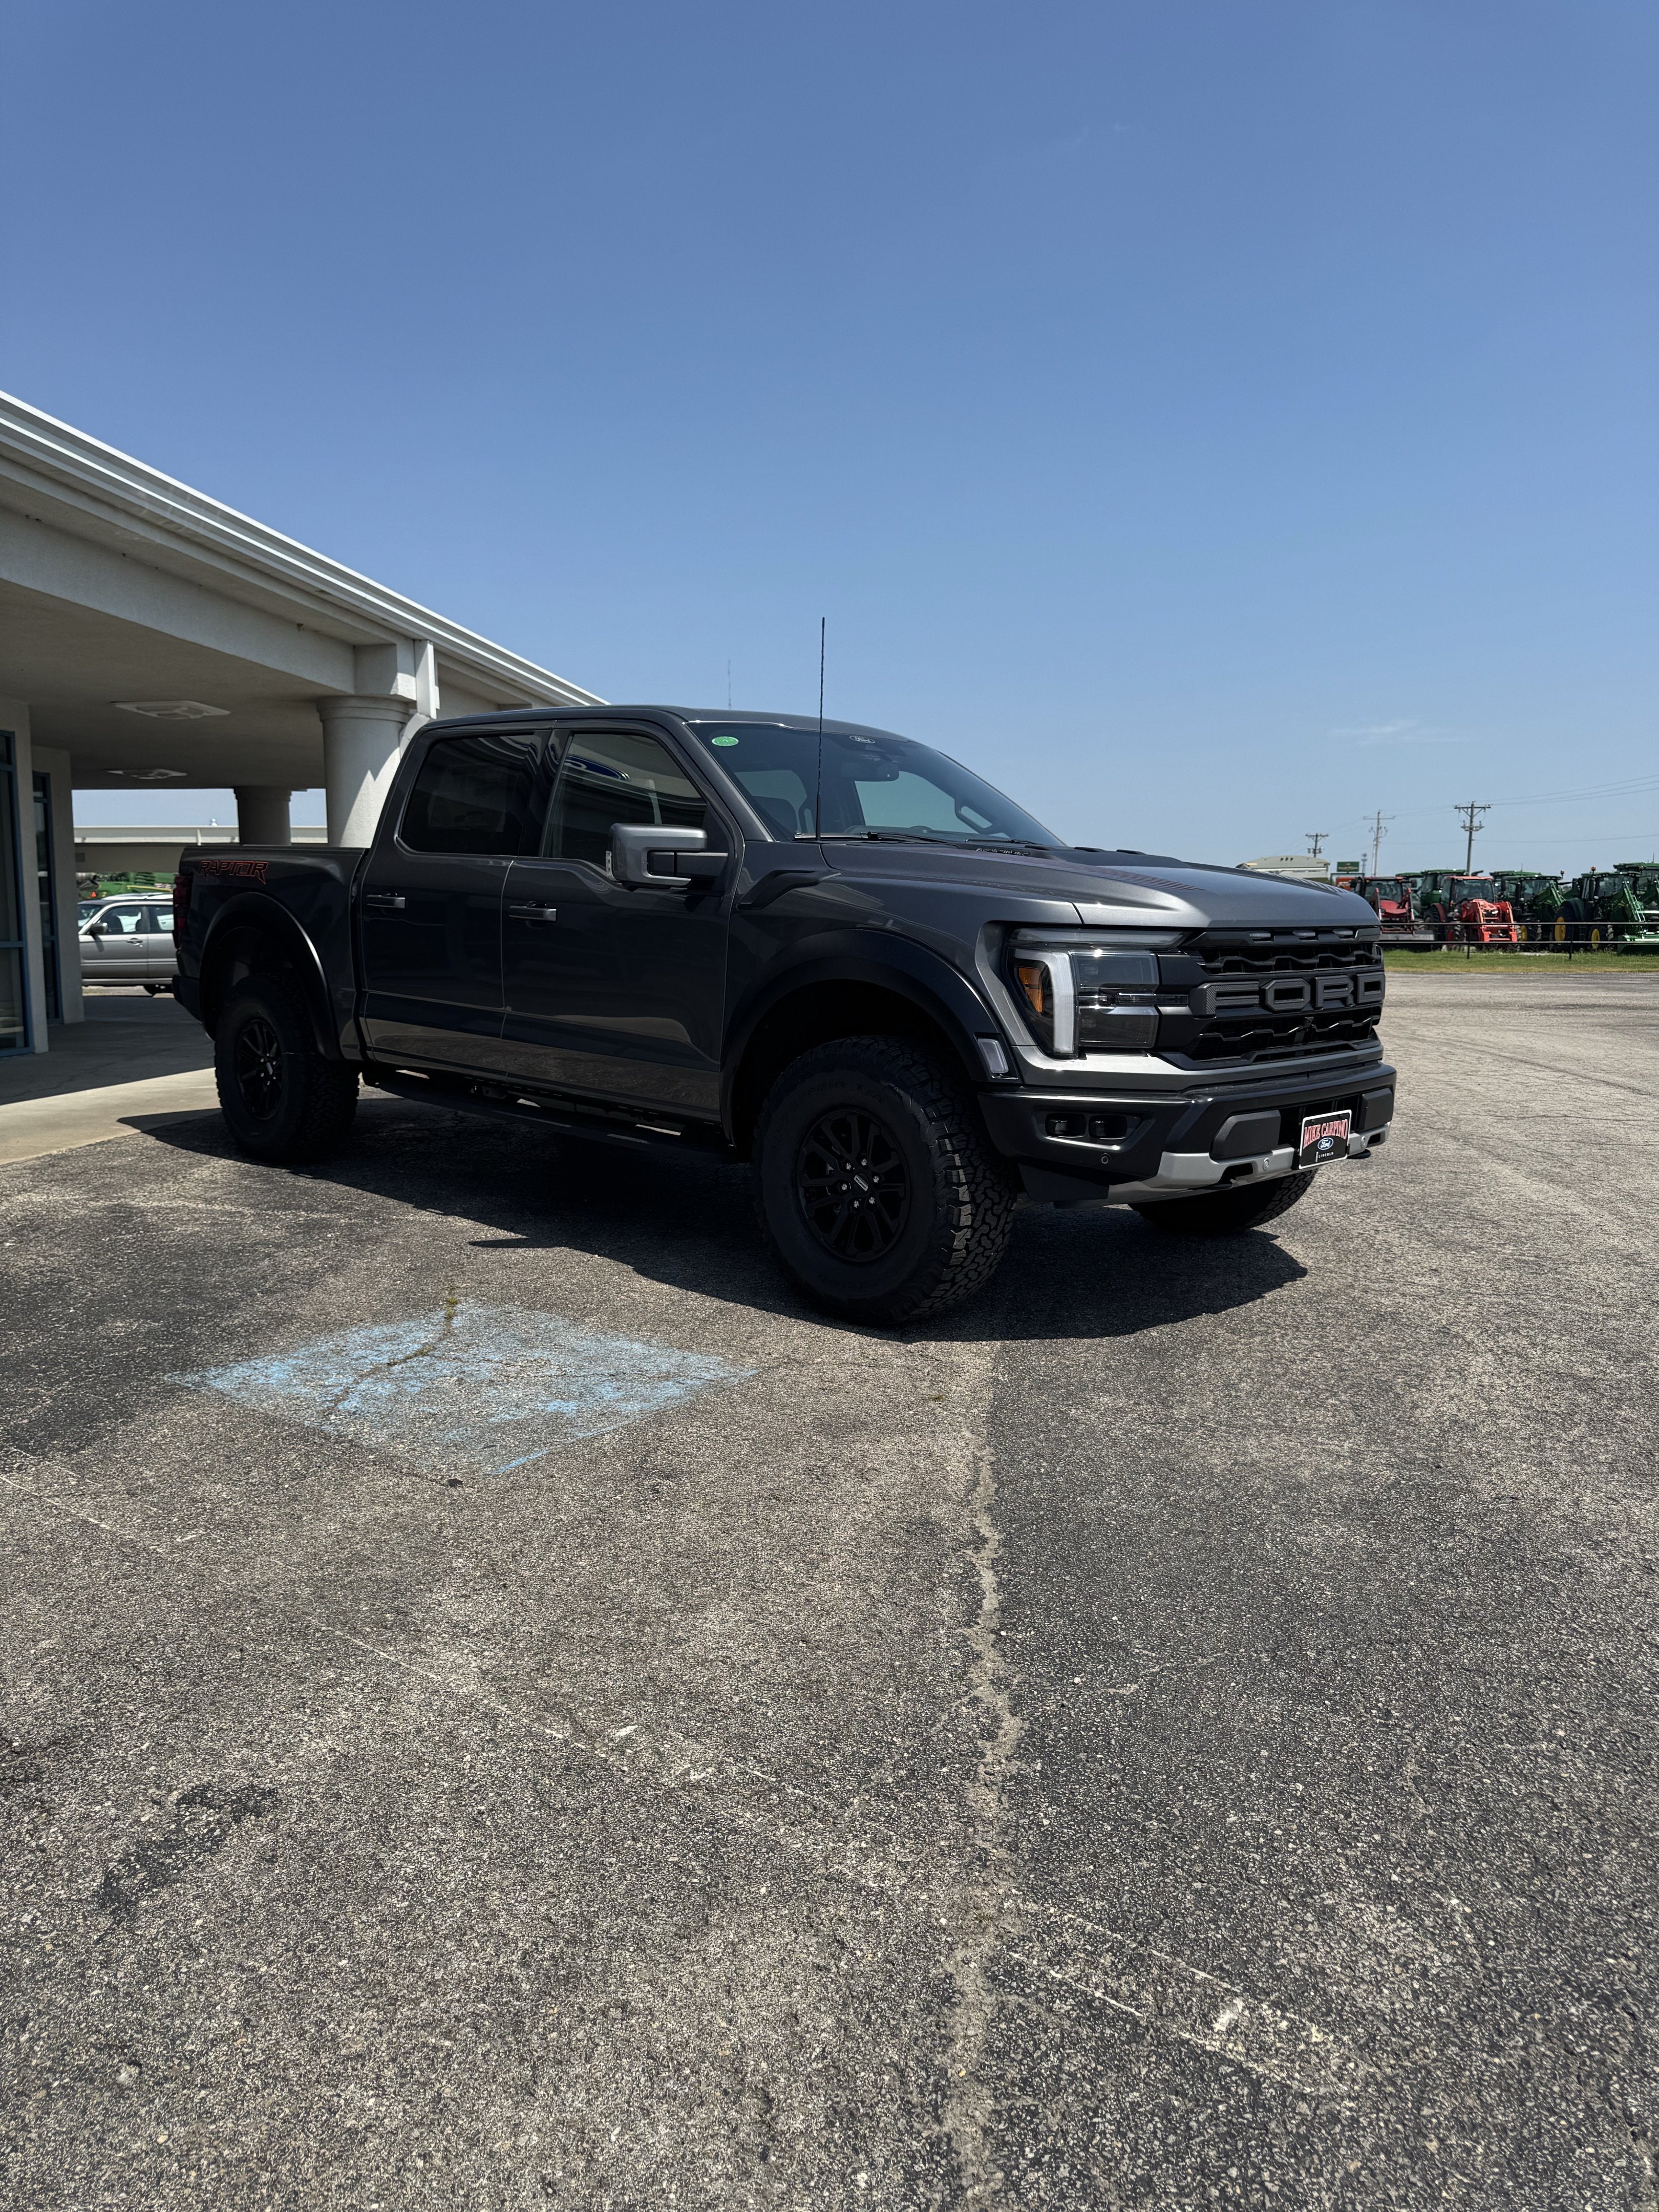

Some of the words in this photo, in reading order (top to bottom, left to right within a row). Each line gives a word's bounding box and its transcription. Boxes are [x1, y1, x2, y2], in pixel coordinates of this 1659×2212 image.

[198, 860, 269, 885] RAPTOR
[1190, 973, 1385, 1019] FORD
[1303, 1124, 1321, 1149] MIKE
[1322, 1119, 1348, 1139] CARPINO
